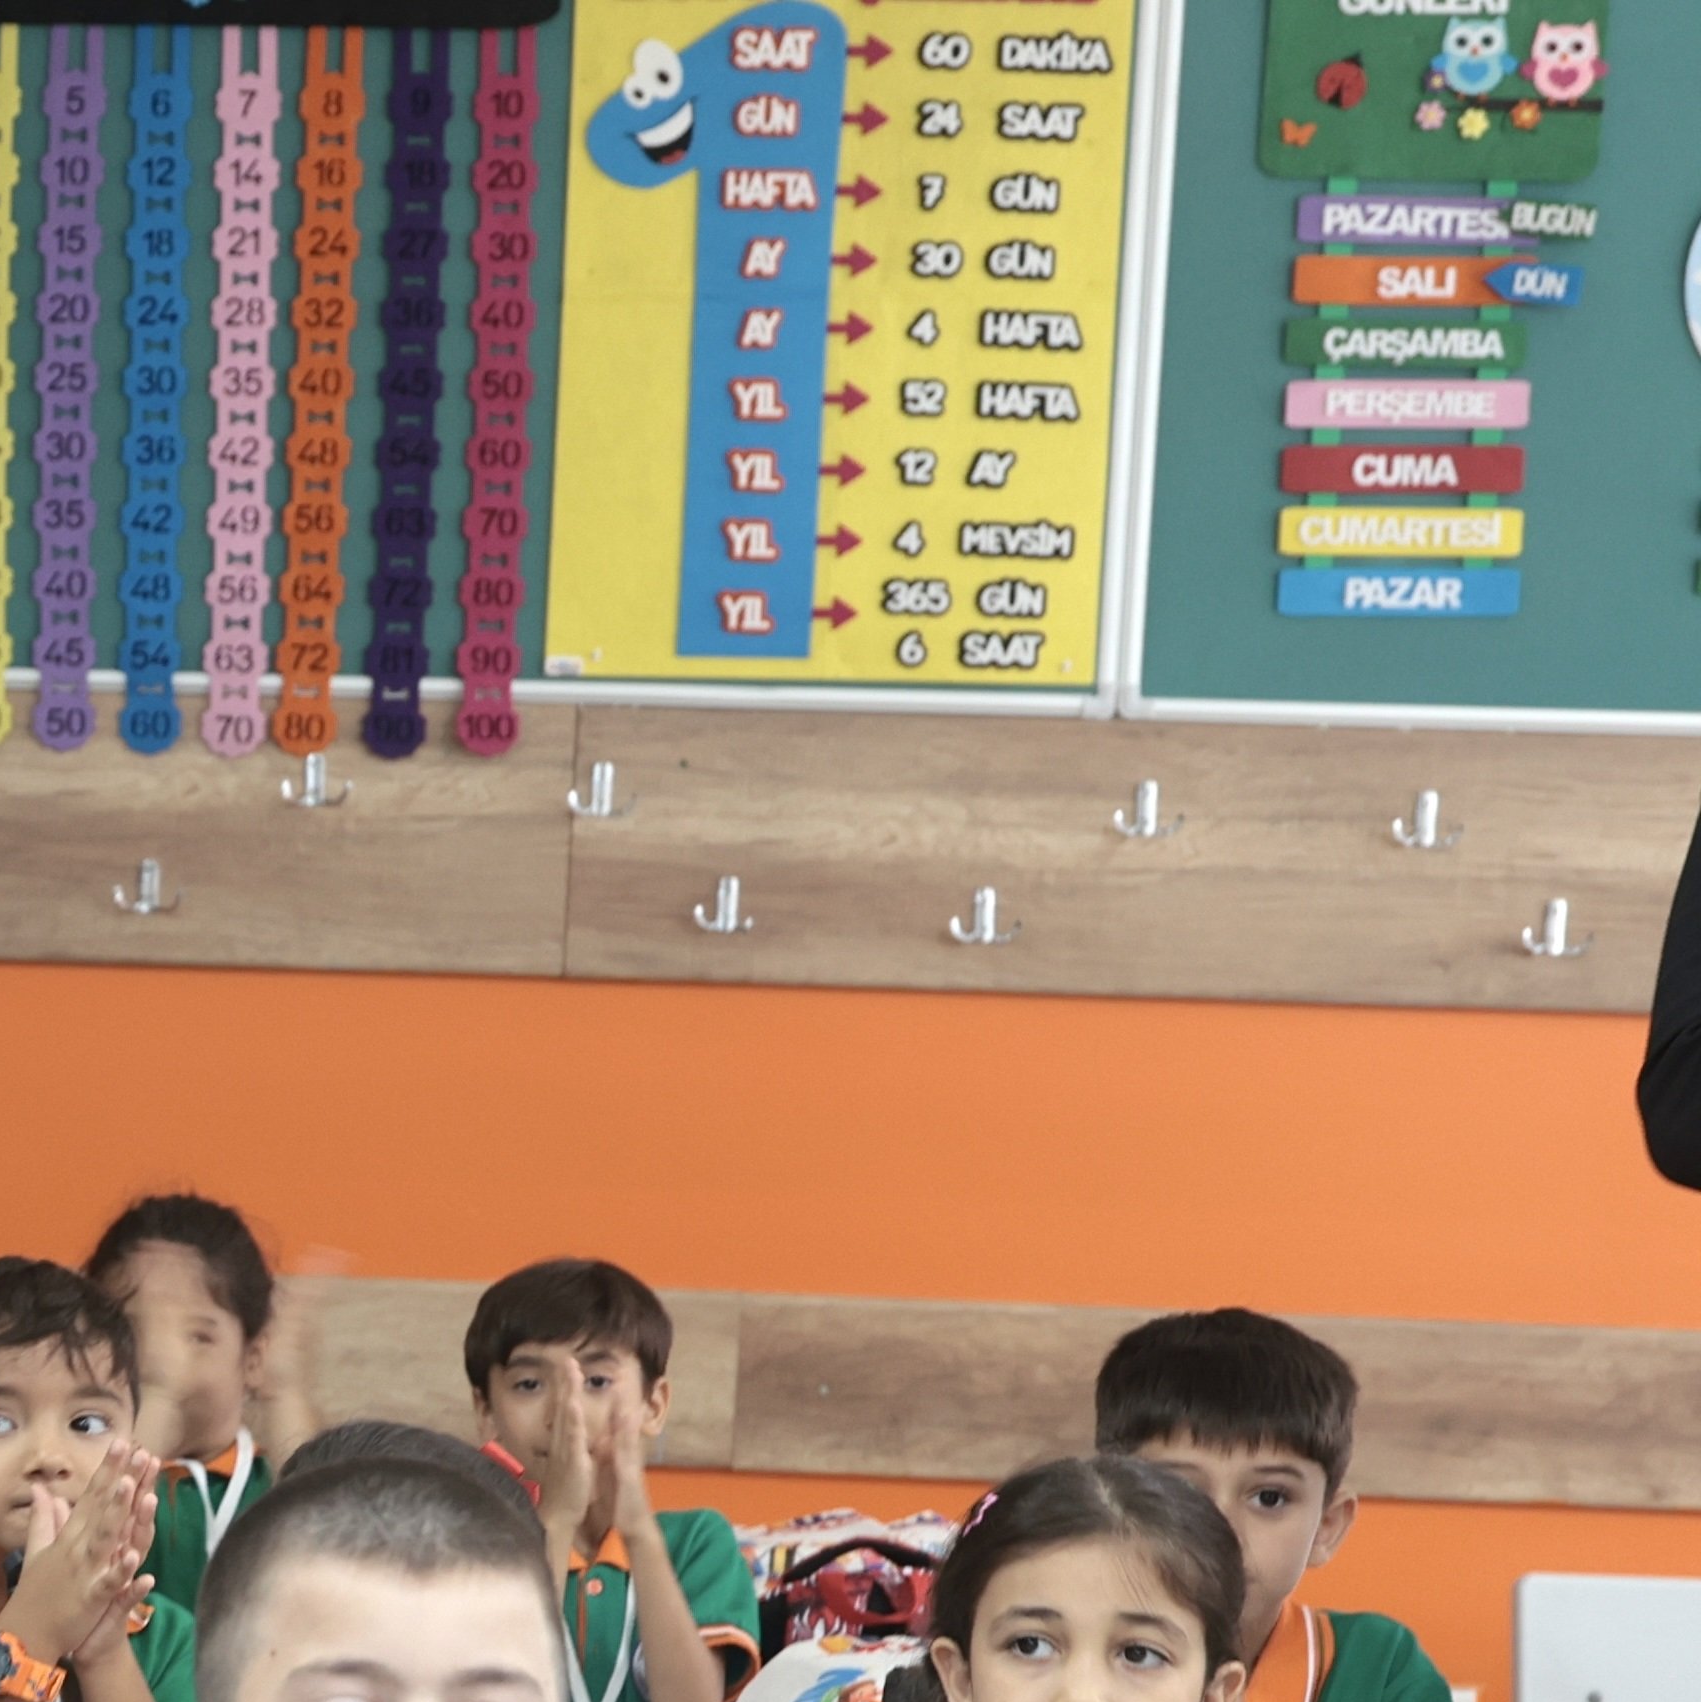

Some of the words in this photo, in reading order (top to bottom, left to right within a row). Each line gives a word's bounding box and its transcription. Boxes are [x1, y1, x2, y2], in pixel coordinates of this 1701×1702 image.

[732, 28, 816, 69] SAAT
[922, 34, 970, 68] 60
[1001, 30, 1110, 71] DAKİKA
[66, 86, 85, 116] 5
[150, 89, 171, 117] 6
[239, 89, 257, 117] 7
[323, 90, 343, 117] 8
[410, 88, 432, 118] 9
[491, 90, 523, 118] 10
[735, 98, 800, 134] GÜN
[919, 101, 962, 135] 24
[1001, 103, 1083, 137] SAAT
[55, 157, 90, 185] 10
[142, 157, 176, 187] 12
[230, 159, 263, 186] 14
[314, 159, 346, 187] 16
[403, 159, 437, 189] 18
[487, 159, 526, 191] 20
[724, 170, 817, 208] HAFTA
[921, 175, 944, 207] 7
[993, 174, 1059, 210] GÜN
[1512, 202, 1597, 236] BUGÜN
[54, 224, 87, 255] 15
[143, 229, 174, 257] 18
[228, 227, 261, 257] 21
[309, 226, 348, 258] 24
[397, 228, 437, 260] 27
[489, 232, 529, 262] 30
[743, 239, 785, 276] AY
[913, 241, 961, 275] 30
[988, 241, 1055, 277] GÜN
[1377, 266, 1456, 298] SALI
[1512, 266, 1567, 298] DÜN
[48, 294, 90, 324] 20
[138, 296, 178, 326] 24
[224, 297, 264, 327] 28
[305, 298, 344, 329] 32
[393, 297, 434, 327] 36
[480, 301, 524, 329] 40
[739, 308, 783, 347] AY
[911, 310, 937, 343] 4
[982, 311, 1081, 348] HAFTA
[1324, 328, 1504, 364] ÇARŞAMBA
[48, 362, 87, 393] 25
[138, 366, 177, 396] 30
[224, 367, 263, 397] 35
[299, 369, 342, 396] 40
[389, 368, 432, 399] 45
[482, 370, 523, 400] 50
[732, 379, 786, 419] YIL
[902, 381, 945, 414] 52
[978, 382, 1079, 419] HAFTA
[1326, 389, 1495, 423] PERŞEMBE
[47, 431, 86, 461] 30
[137, 435, 176, 465] 36
[219, 437, 259, 466] 42
[297, 440, 338, 466] 48
[388, 438, 431, 467] 54
[478, 439, 521, 467] 60
[729, 449, 783, 490] YIL
[899, 450, 935, 483] 12
[968, 451, 1014, 486] AY
[1352, 454, 1457, 486] CUMA
[46, 499, 85, 529] 35
[131, 504, 172, 534] 42
[218, 506, 260, 533] 49
[295, 504, 334, 534] 56
[384, 508, 426, 539] 63
[480, 507, 518, 536] 70
[1300, 512, 1501, 546] CUMARTESİ
[724, 519, 778, 561] YIL
[896, 521, 922, 555] 4
[962, 521, 1074, 557] MEVSİM
[44, 571, 87, 599] 40
[130, 575, 170, 601] 48
[218, 576, 257, 604] 56
[292, 575, 332, 602] 64
[384, 577, 422, 608] 72
[472, 579, 514, 607] 80
[1343, 576, 1462, 608] PAZAR
[718, 590, 773, 632] YIL
[885, 581, 950, 614] 365
[979, 580, 1046, 616] GÜN
[43, 638, 84, 667] 45
[130, 641, 170, 671] 54
[214, 645, 254, 674] 63
[292, 643, 329, 673] 72
[379, 646, 414, 674] 81
[470, 646, 512, 675] 90
[900, 632, 925, 665] 6
[962, 631, 1043, 666] SAAT
[47, 708, 86, 737] 50
[130, 711, 171, 739] 60
[216, 715, 253, 743] 70
[284, 713, 325, 741] 80
[370, 712, 415, 743] 90
[465, 715, 514, 740] 100
